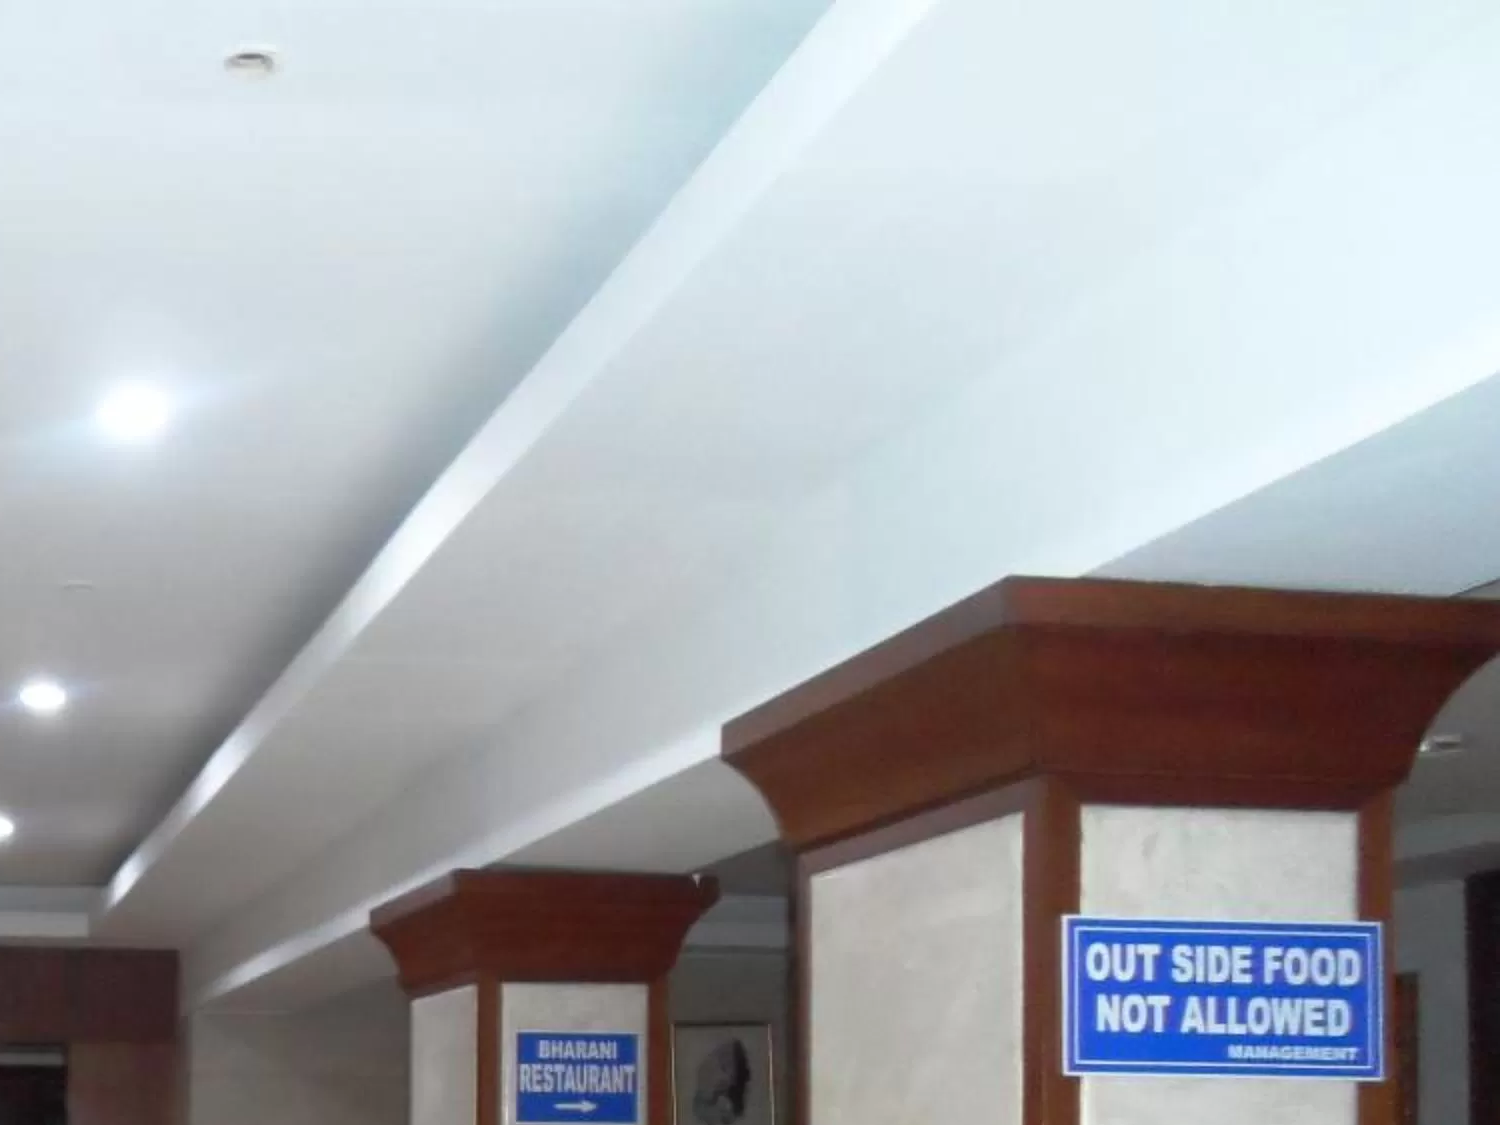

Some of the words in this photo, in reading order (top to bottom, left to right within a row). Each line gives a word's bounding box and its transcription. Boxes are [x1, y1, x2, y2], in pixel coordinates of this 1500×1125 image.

[1085, 942, 1161, 982] OUT
[1171, 944, 1252, 984] SIDE
[1263, 947, 1361, 986] FOOD
[1096, 994, 1171, 1033] NOT
[1180, 997, 1352, 1036] ALLOWED
[538, 1040, 617, 1059] BHARANI
[1228, 1045, 1359, 1061] MANAGEMENT
[519, 1063, 635, 1093] RESTAURANT
